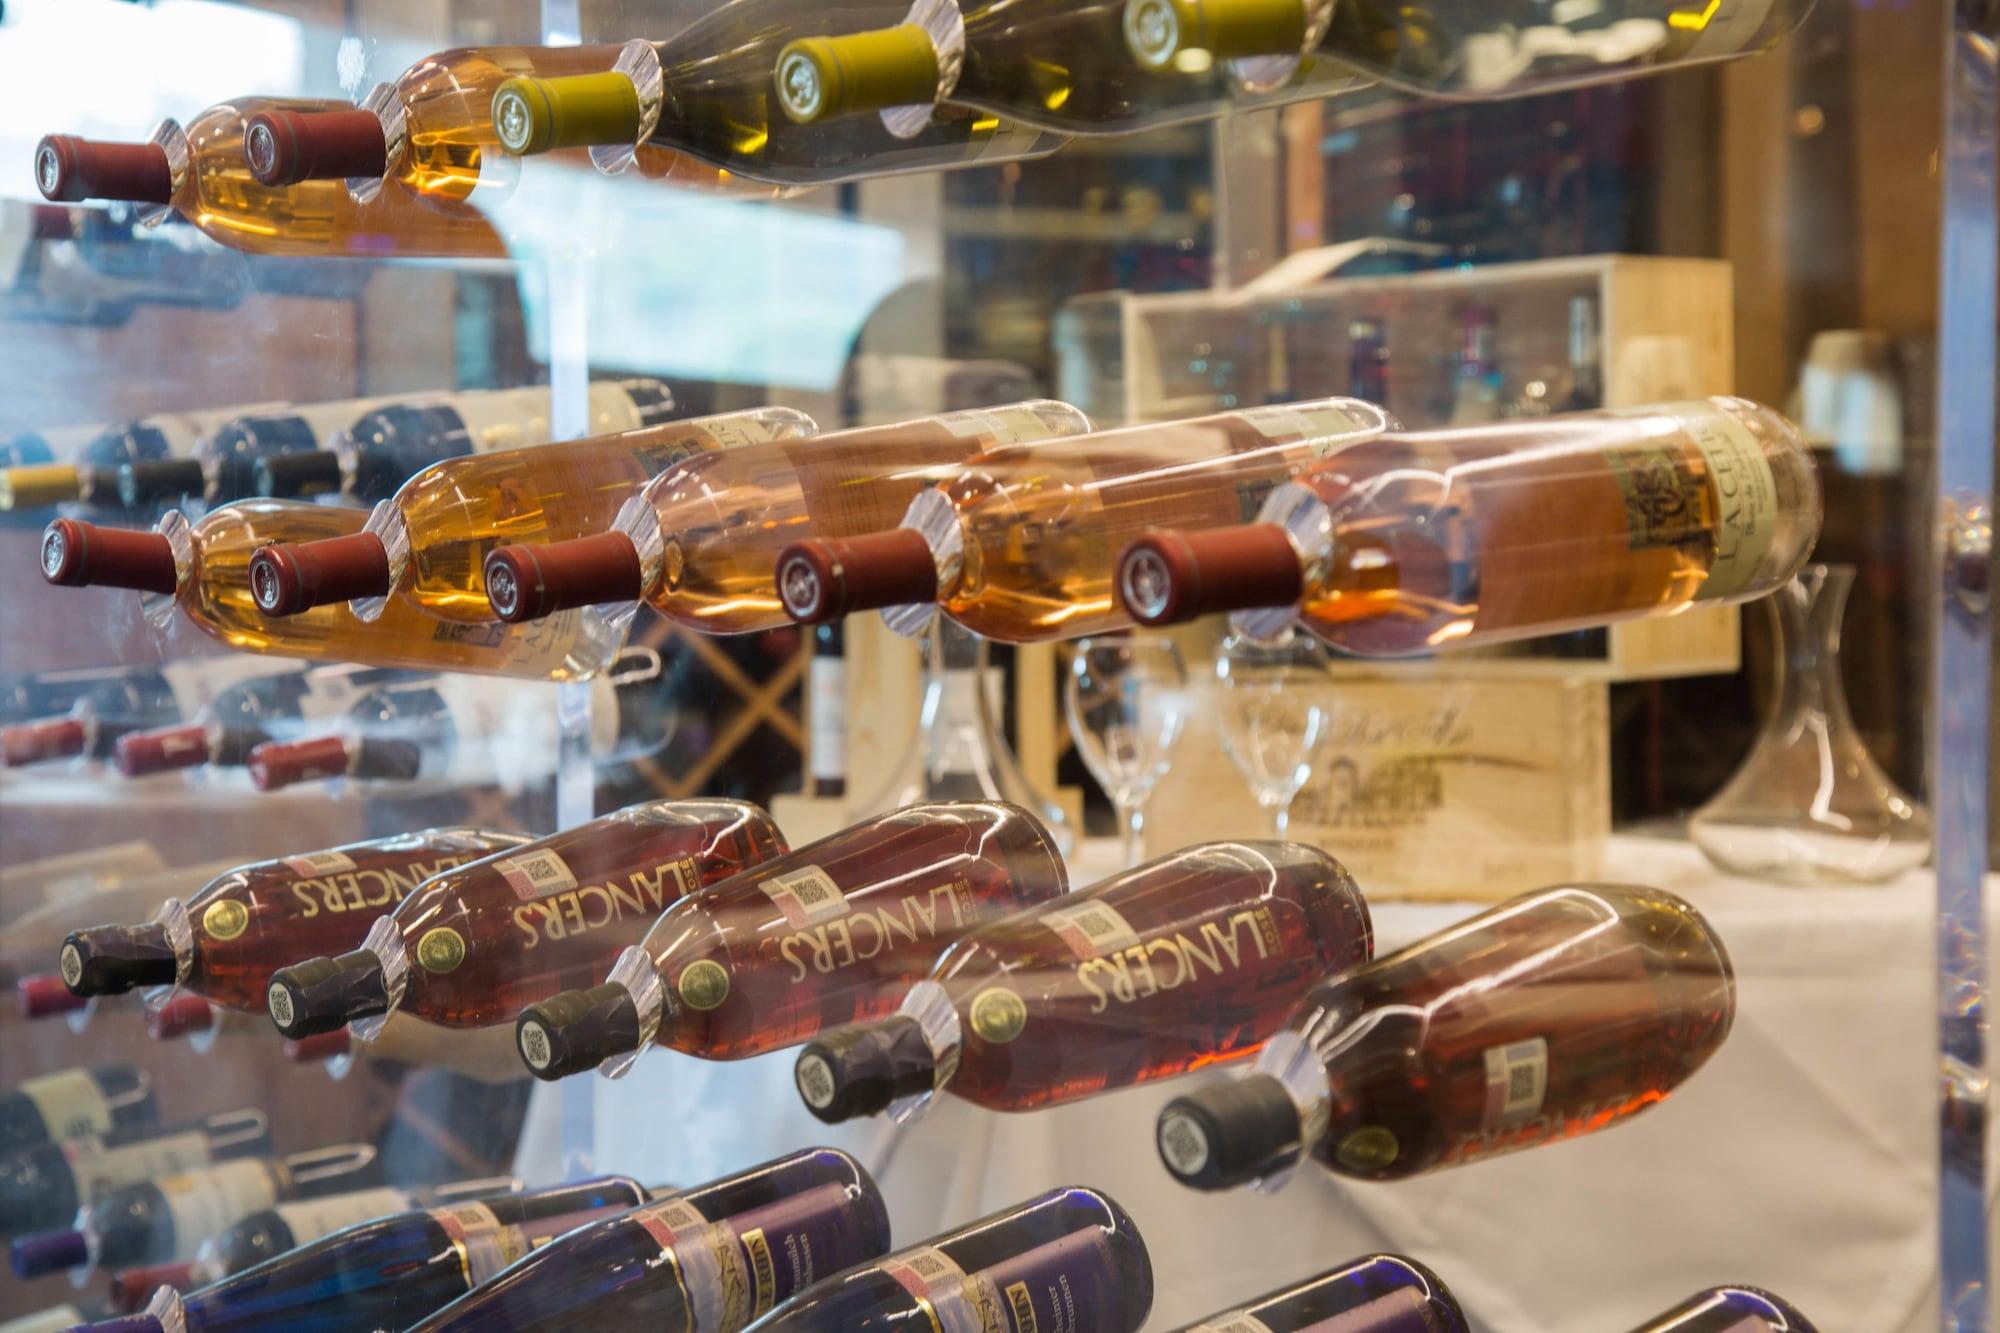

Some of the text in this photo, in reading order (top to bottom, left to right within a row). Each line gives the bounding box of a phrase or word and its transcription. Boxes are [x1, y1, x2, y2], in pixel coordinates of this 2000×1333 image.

[513, 861, 689, 949] LANCERS
[780, 883, 963, 985] LANCERS
[1077, 911, 1268, 1014] LANCERS
